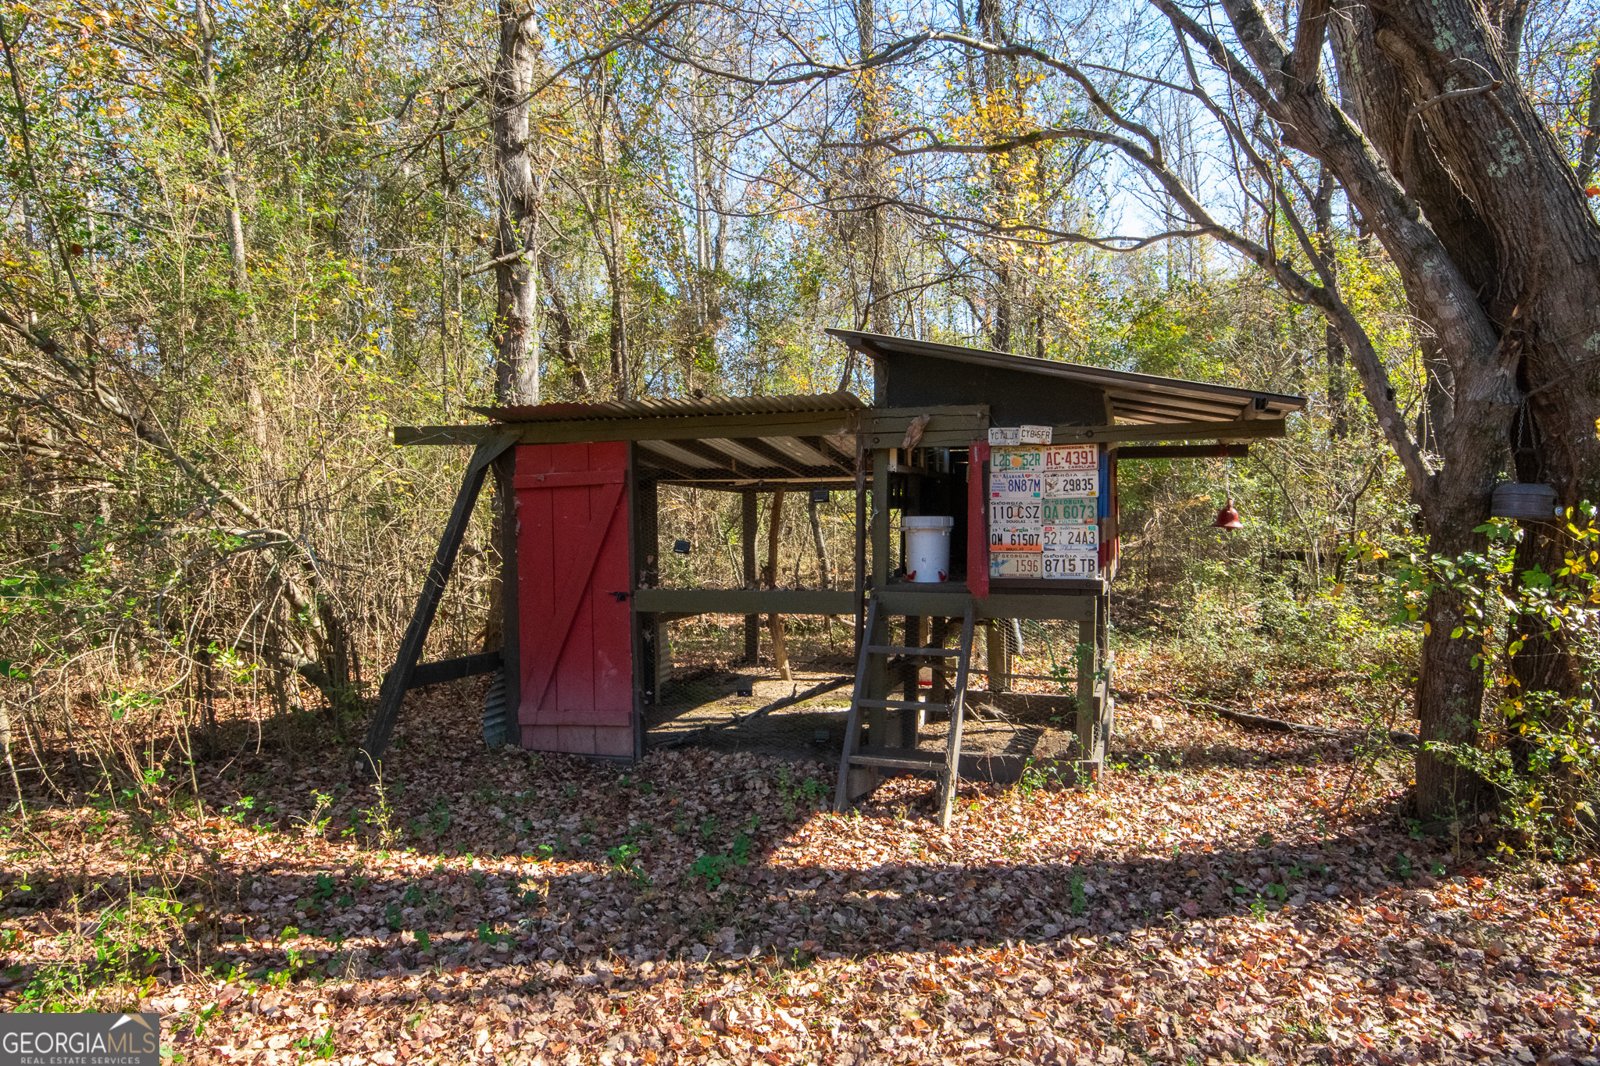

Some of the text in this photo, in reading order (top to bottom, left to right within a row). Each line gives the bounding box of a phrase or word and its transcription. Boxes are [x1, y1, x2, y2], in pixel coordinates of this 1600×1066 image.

[1008, 479, 1041, 492] 8N87M
[1063, 478, 1094, 492] 29835
[1010, 534, 1040, 546] 61507
[1044, 532, 1057, 544] 52
[1068, 531, 1096, 544] 24A3
[1016, 560, 1038, 572] 1596
[1044, 559, 1096, 572] 8715 TB
